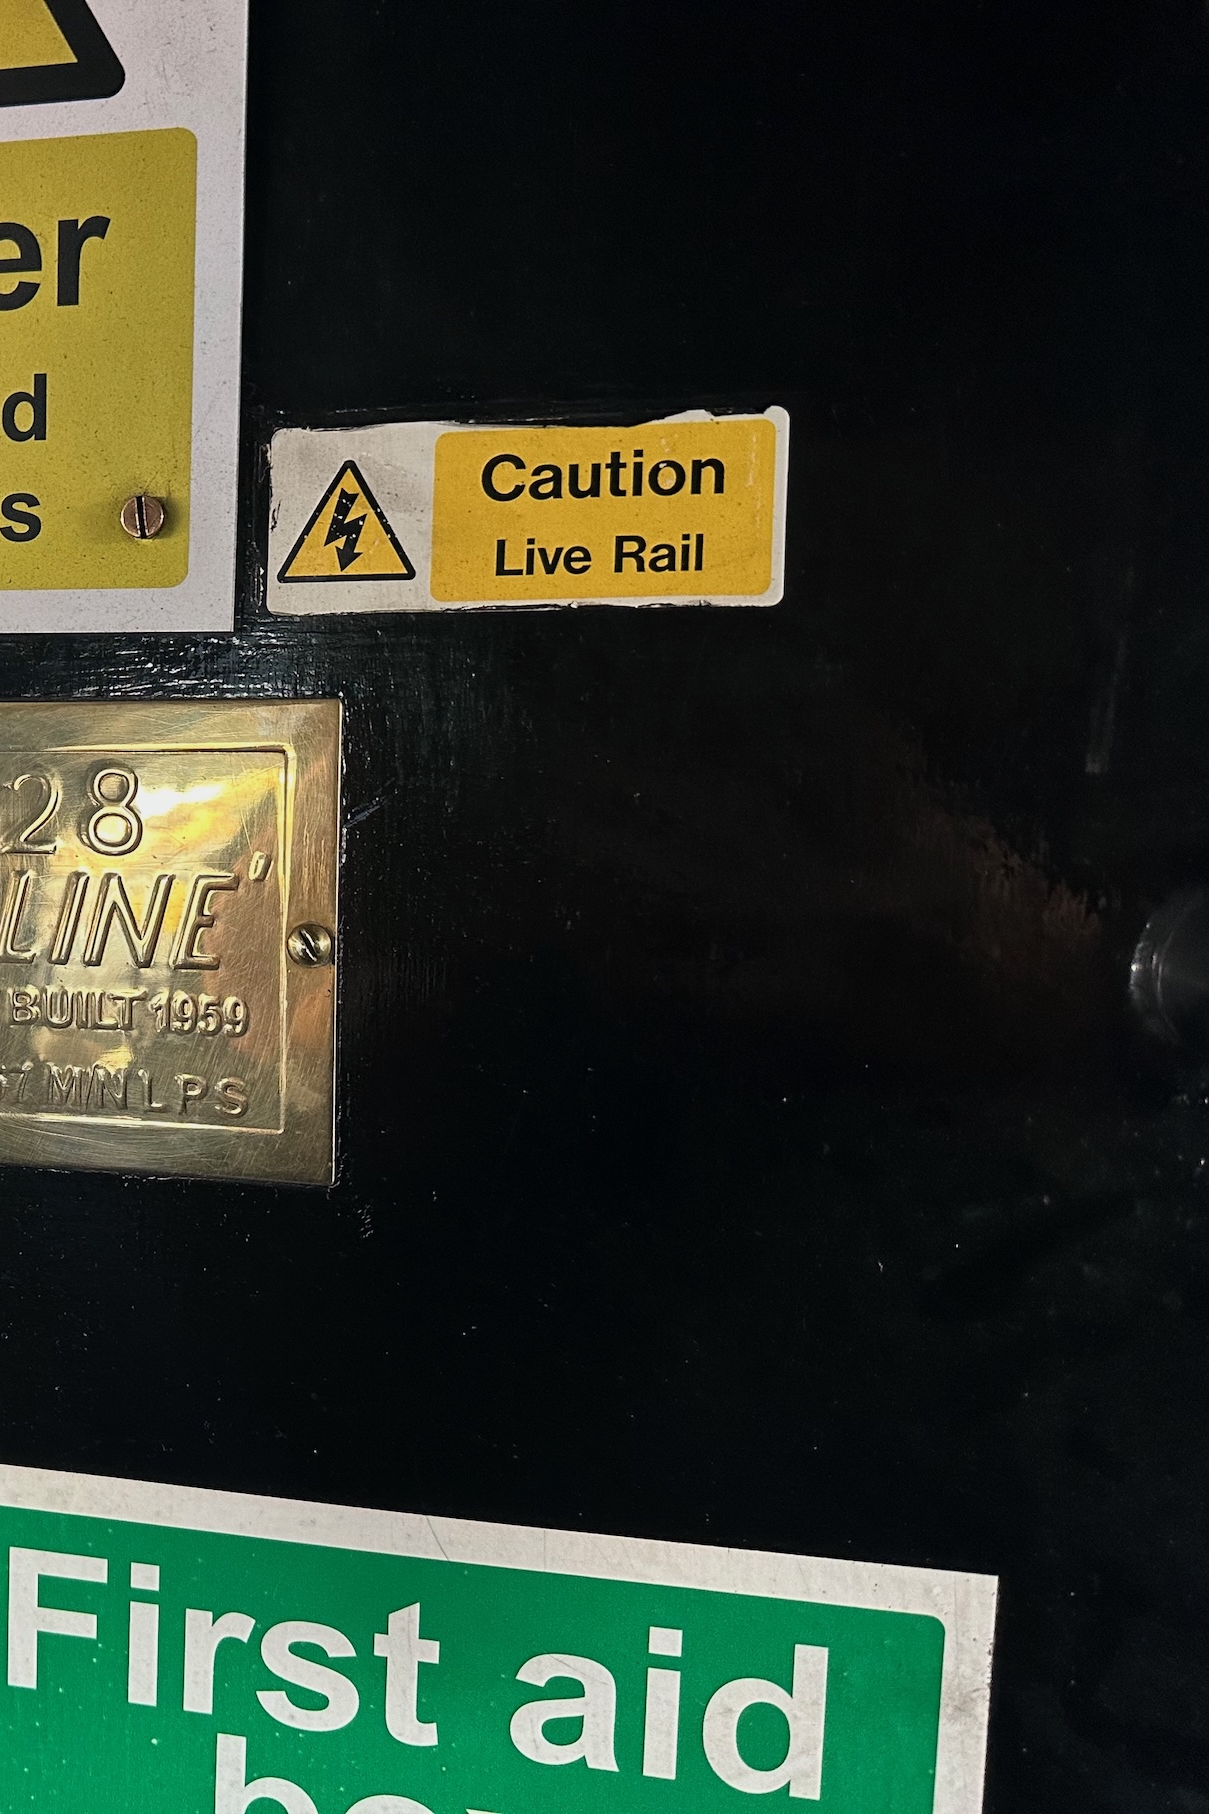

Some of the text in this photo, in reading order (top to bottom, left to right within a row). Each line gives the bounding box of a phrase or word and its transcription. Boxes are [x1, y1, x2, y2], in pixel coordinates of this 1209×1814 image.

[481, 449, 725, 502] Caution
[495, 533, 704, 576] Live Rail
[151, 991, 251, 1038] 1959
[7, 1545, 438, 1747] First
[509, 1626, 829, 1800] aid
